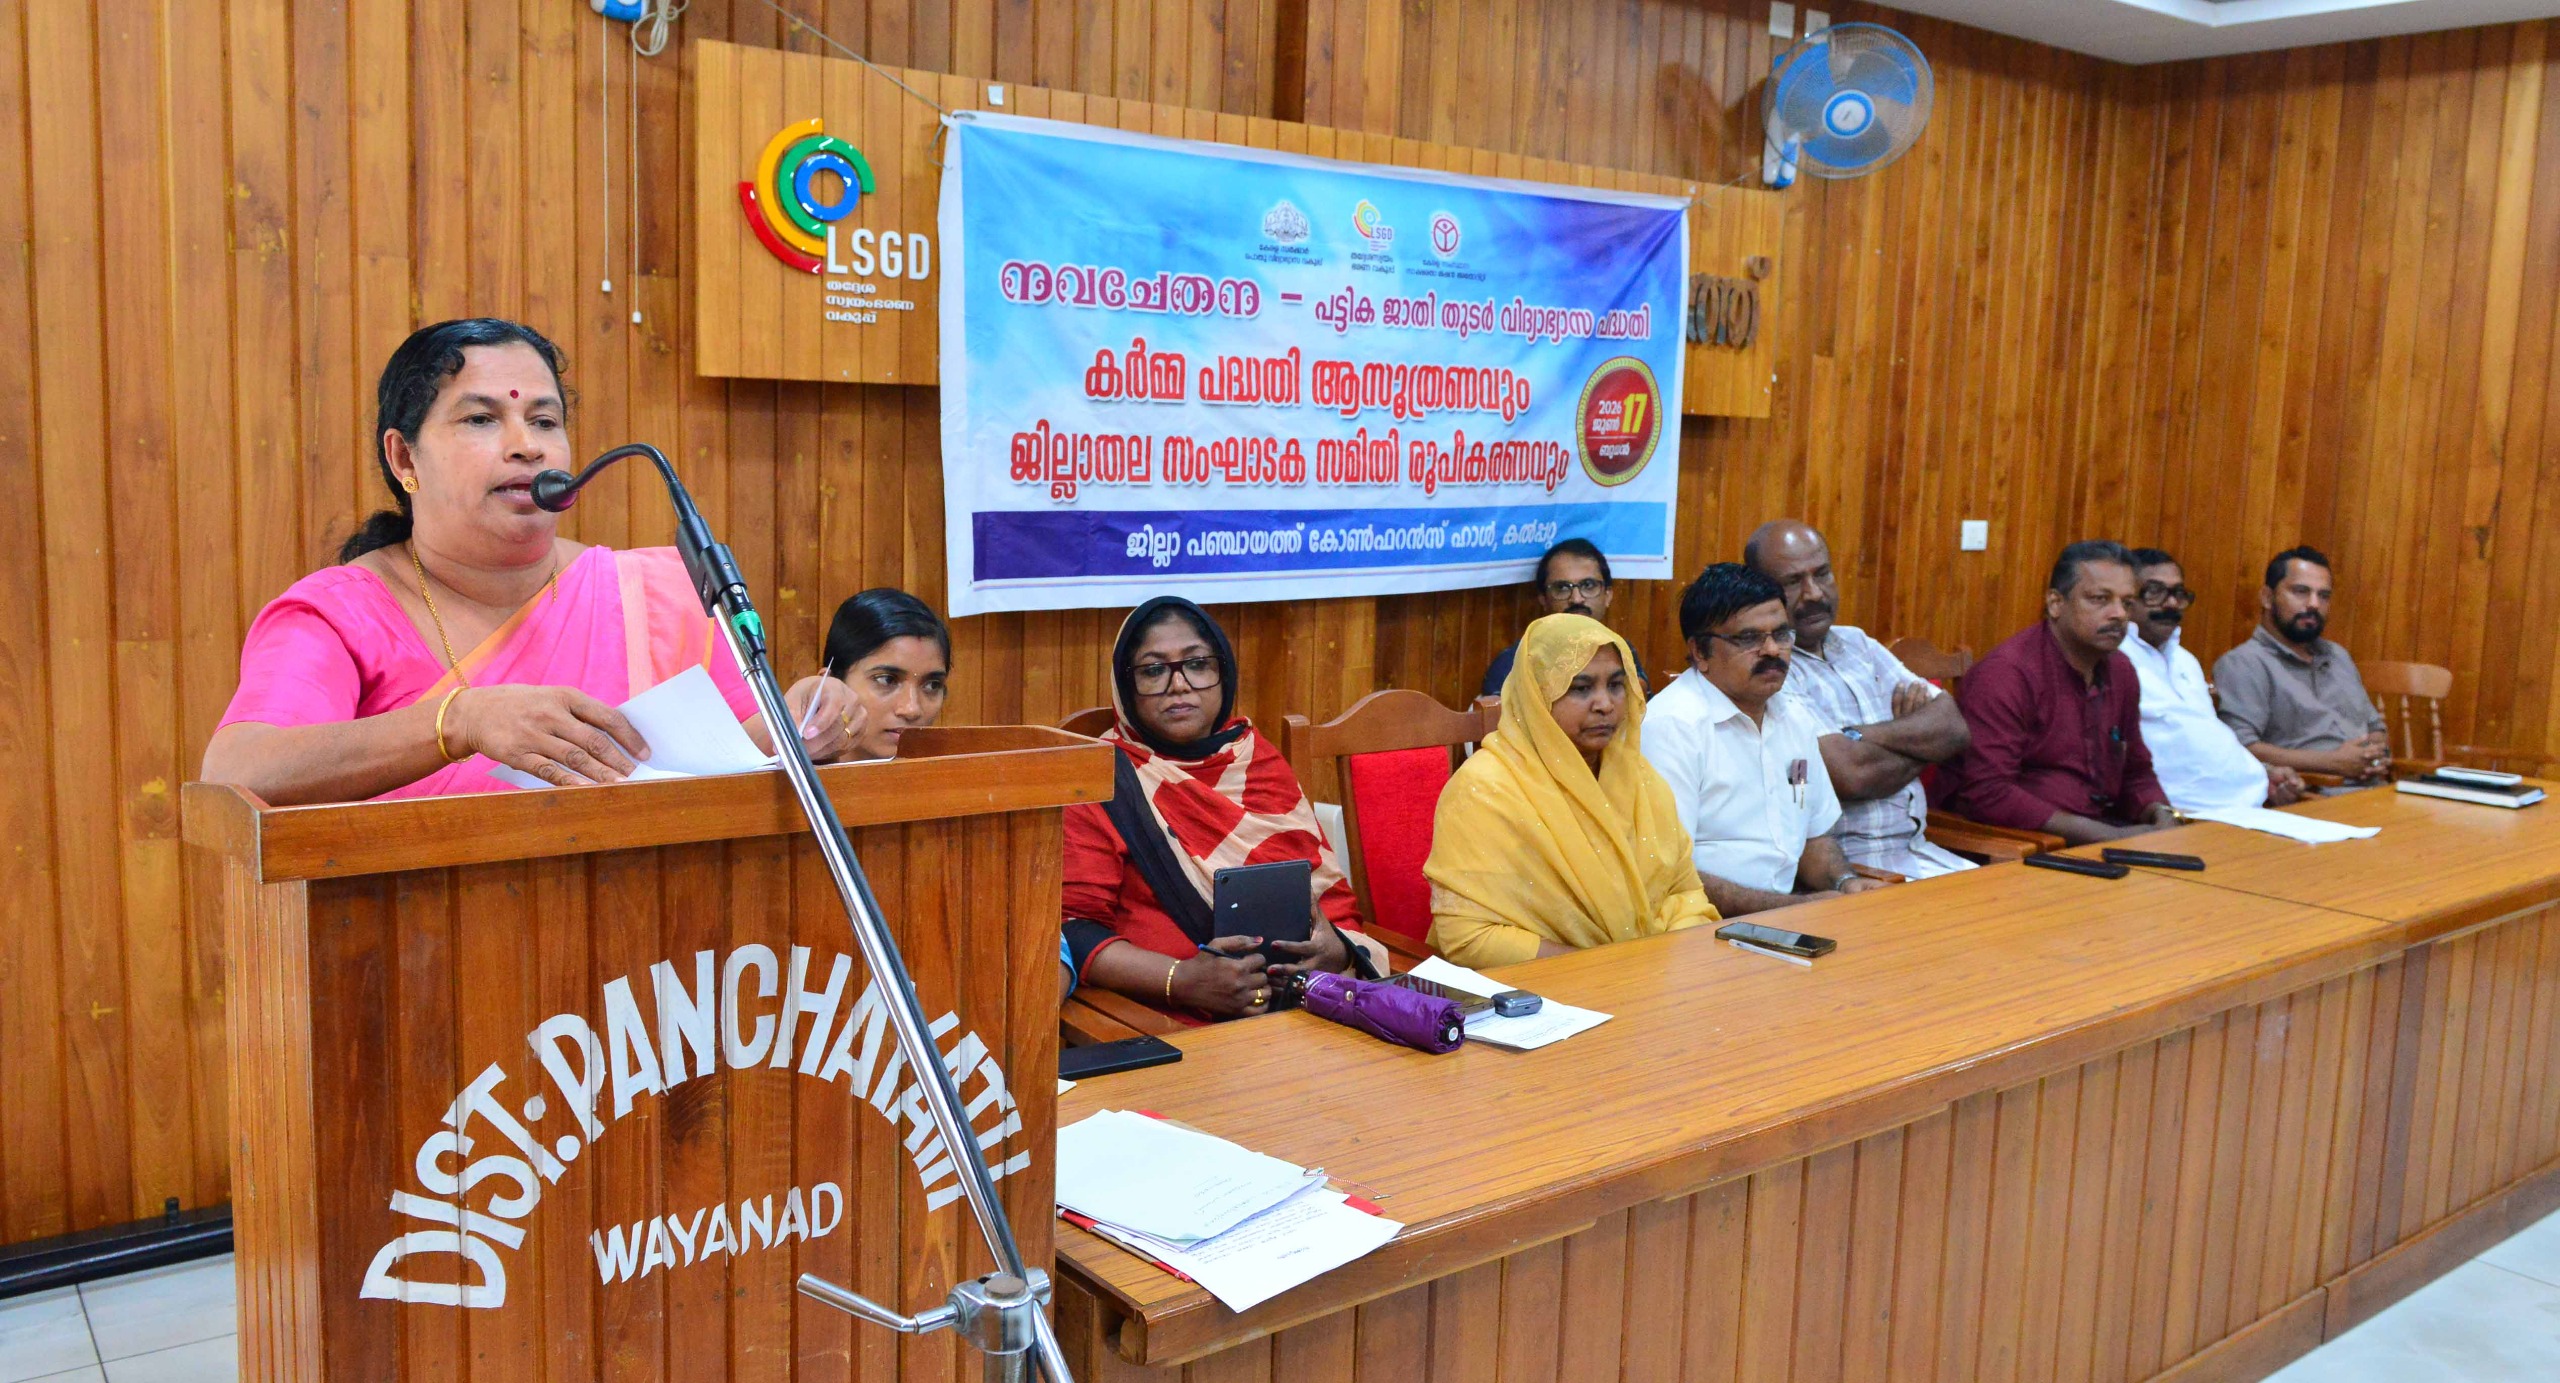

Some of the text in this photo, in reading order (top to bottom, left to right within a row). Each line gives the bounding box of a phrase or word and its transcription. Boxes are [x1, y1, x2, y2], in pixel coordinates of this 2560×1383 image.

[827, 226, 931, 280] LSGD
[1370, 227, 1393, 240] LSGD
[1001, 261, 1260, 316] നവചേതന
[1315, 287, 1374, 332] പട്ടിക
[1383, 291, 1435, 327] ജാതി
[1442, 297, 1494, 337] തുടർ
[1501, 298, 1593, 342] വിദ്യാഭ്യാസ
[1597, 303, 1651, 338] പദ്ധതി
[1085, 337, 1530, 421] കർമ്മ പദ്ധതി ആസൂത്രണവും
[1599, 400, 1622, 414] 2026
[1622, 393, 1648, 433] 17
[1010, 419, 1569, 499] ജില്ലാതല സംഘാടക സമിതി രൂപീകരണവും
[1127, 524, 1180, 567] ജില്ലാ
[1187, 522, 1304, 556] പഞ്ചായത്ത്
[1309, 520, 1450, 553] കോൺഫറൻസ്
[1451, 521, 1499, 551] ഹാൾ,
[590, 1181, 843, 1285] WAYANAD
